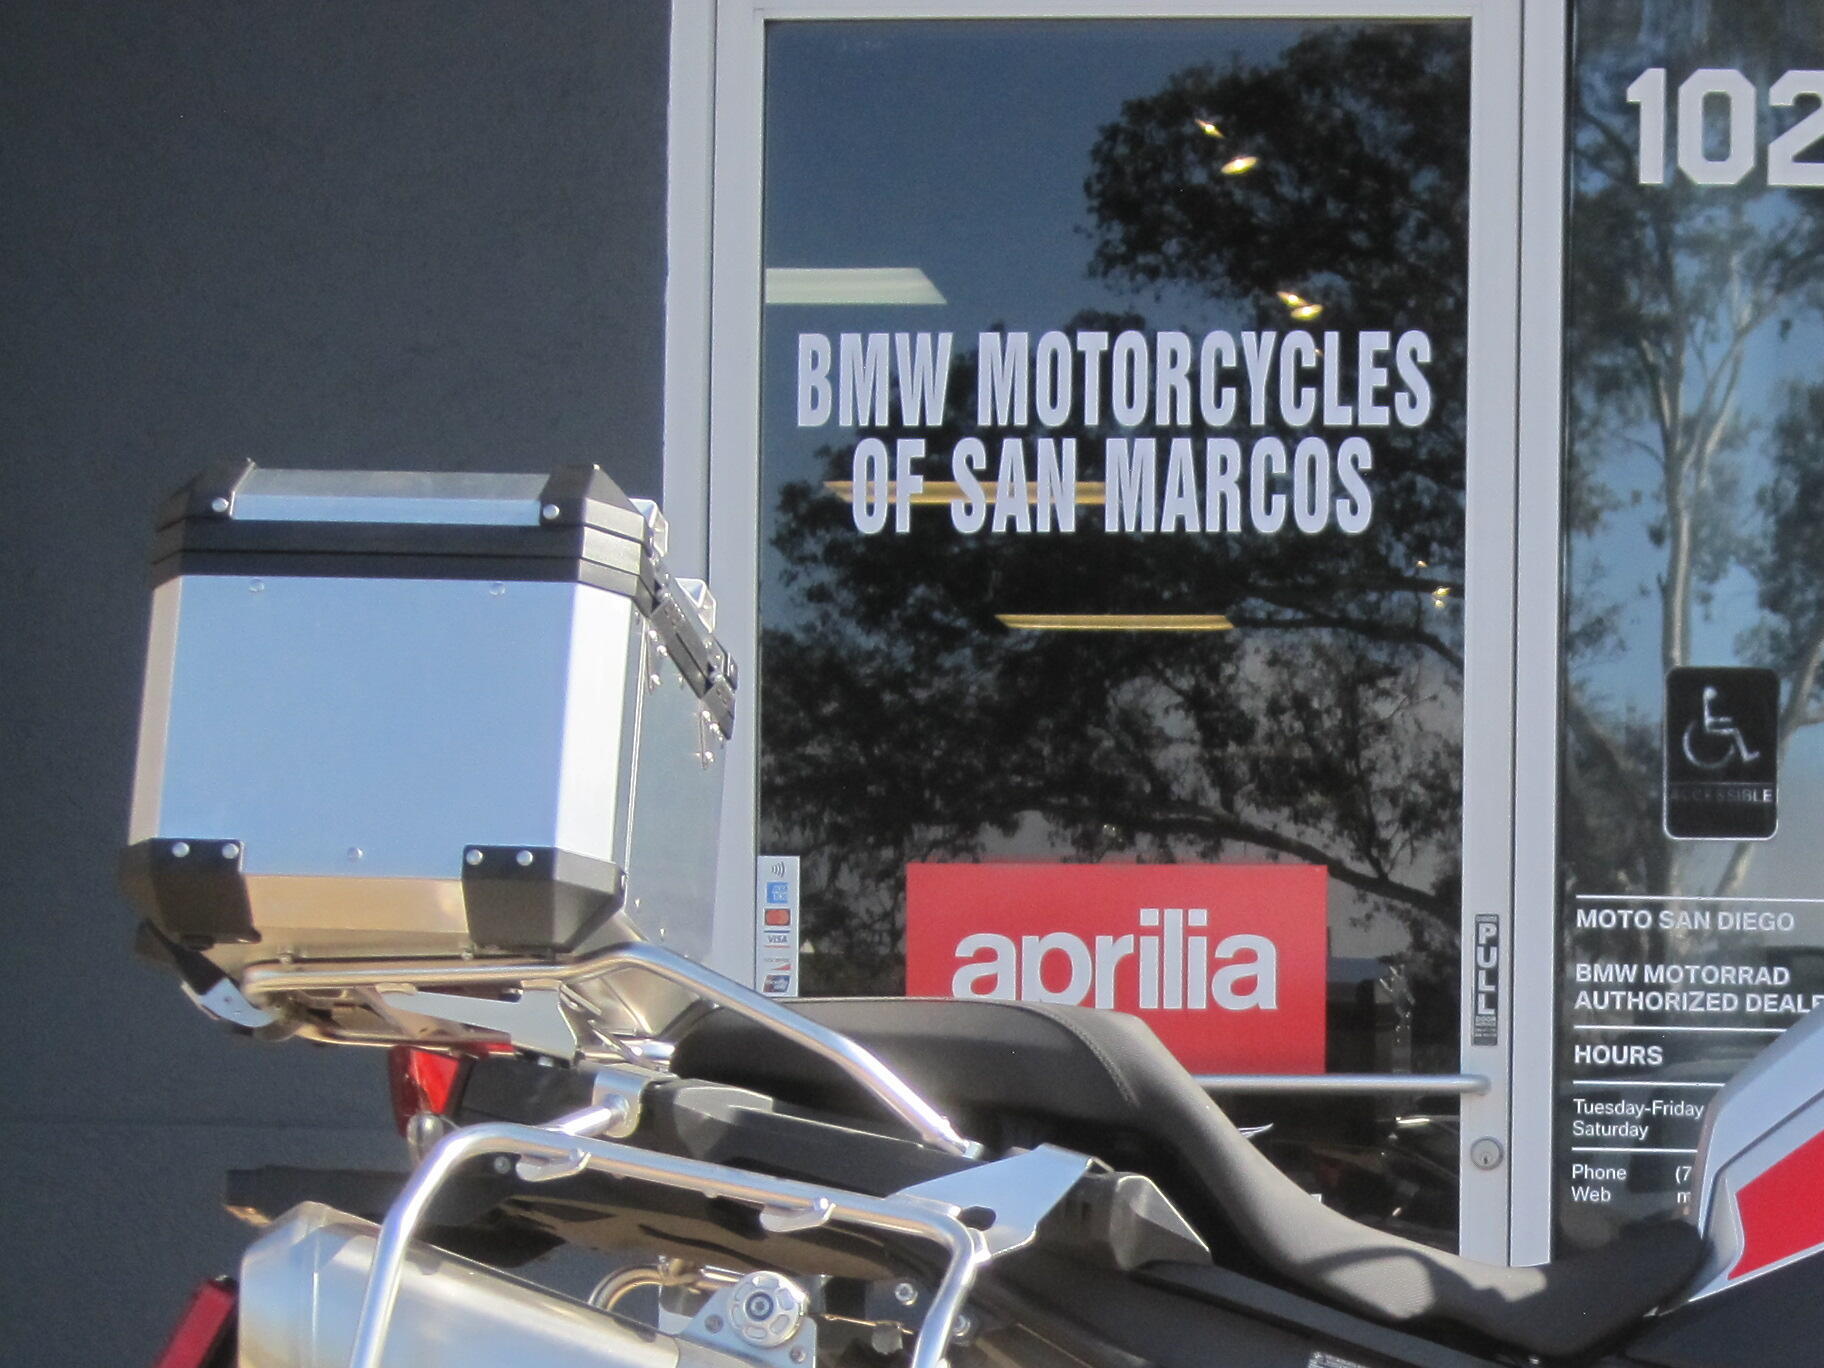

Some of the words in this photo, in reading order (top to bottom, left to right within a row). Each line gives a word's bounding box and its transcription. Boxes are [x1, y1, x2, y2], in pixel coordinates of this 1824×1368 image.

[797, 332, 953, 428] BMW
[976, 330, 1432, 428] MOTORCYCLES
[852, 437, 926, 535] OF
[951, 437, 1077, 535] SAN
[1104, 437, 1373, 535] MARCOS
[1576, 909, 1652, 930] MOTO
[1658, 911, 1710, 931] SAN
[1717, 912, 1795, 932] DIEGO
[951, 908, 1278, 1011] aprilia
[1476, 922, 1498, 1015] PULL
[1575, 964, 1638, 984] BMW
[1643, 964, 1790, 986] MOTORRAD
[1573, 991, 1739, 1012] AUTHORIZED
[1573, 1045, 1664, 1066] HOURS
[1572, 1098, 1704, 1119] Tuesday-Friday
[1572, 1120, 1649, 1139] Saturday
[1571, 1164, 1627, 1181] Phone
[1571, 1186, 1611, 1203] Web
